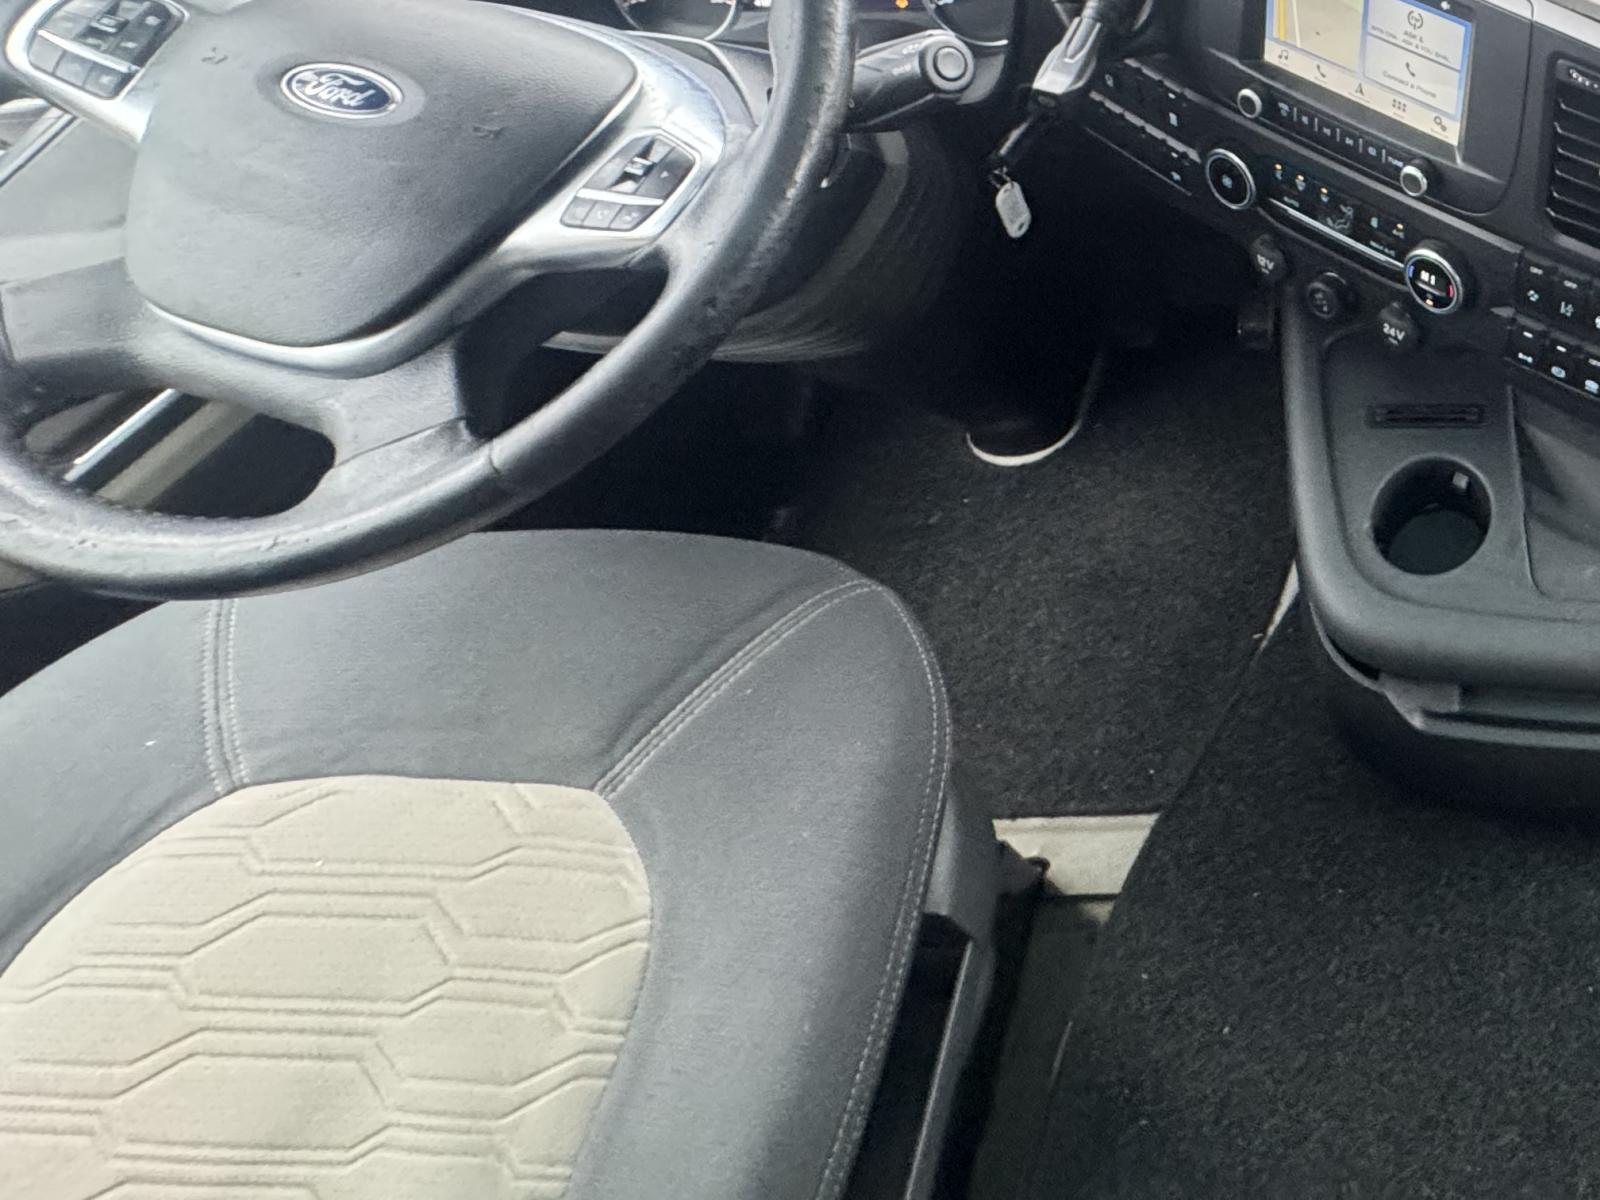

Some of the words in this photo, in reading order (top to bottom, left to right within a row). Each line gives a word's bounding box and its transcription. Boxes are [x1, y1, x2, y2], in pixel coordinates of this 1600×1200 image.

[304, 72, 377, 108] Ford
[1256, 253, 1276, 271] 12V
[1382, 322, 1405, 342] 24V
